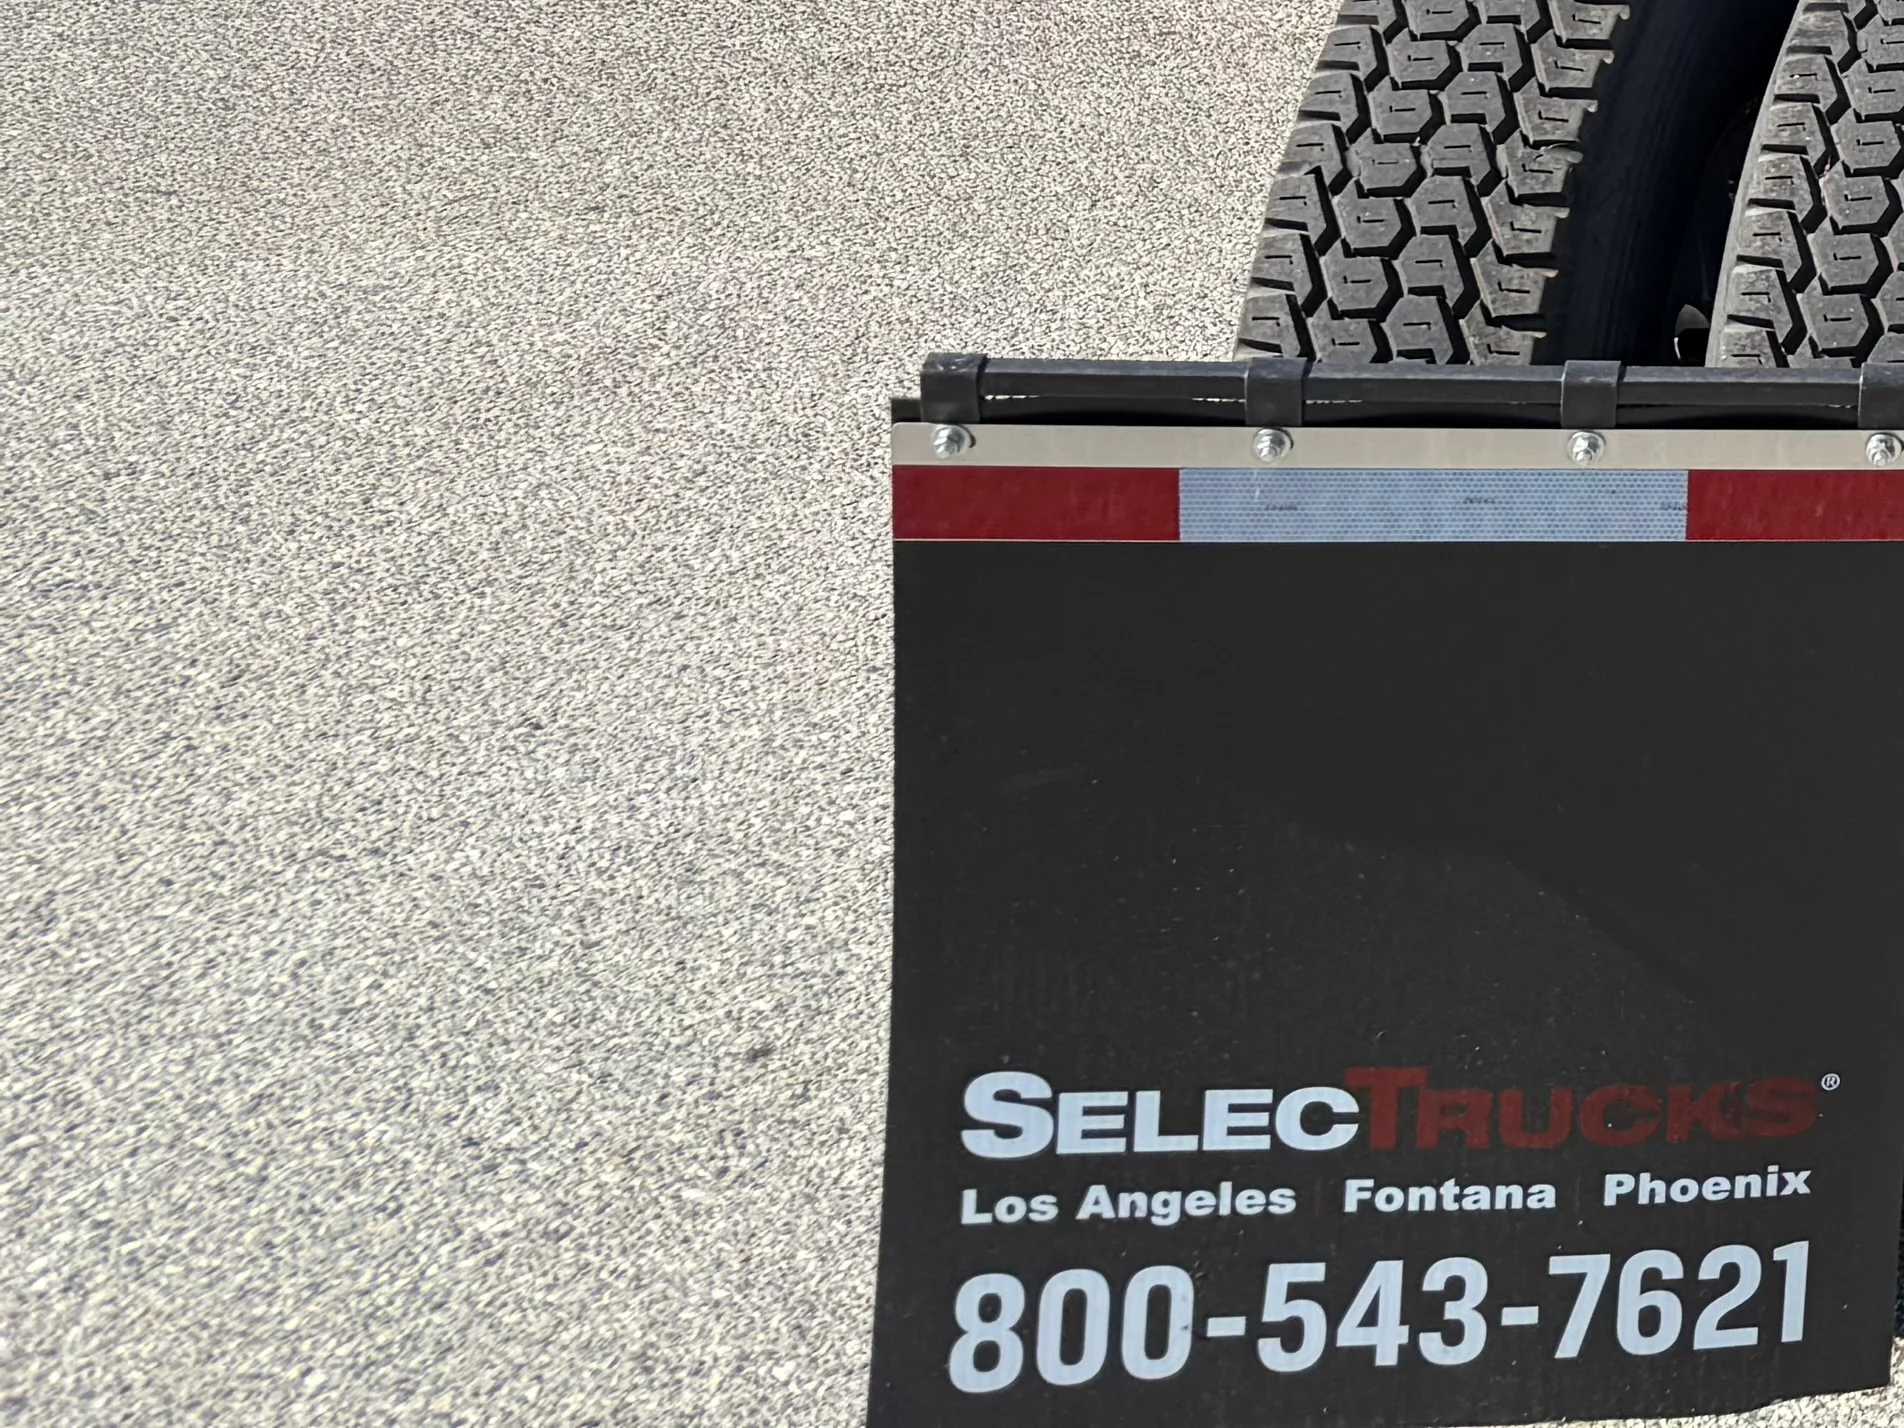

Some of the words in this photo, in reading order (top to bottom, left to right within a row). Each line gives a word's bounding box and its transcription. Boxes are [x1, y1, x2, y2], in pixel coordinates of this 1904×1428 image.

[962, 1188, 1058, 1225] Los
[1076, 1178, 1296, 1226] Angeles
[1345, 1177, 1555, 1213] Fontana
[1604, 1164, 1811, 1207] Phoenix
[949, 1241, 1809, 1393] 800-543-7621
